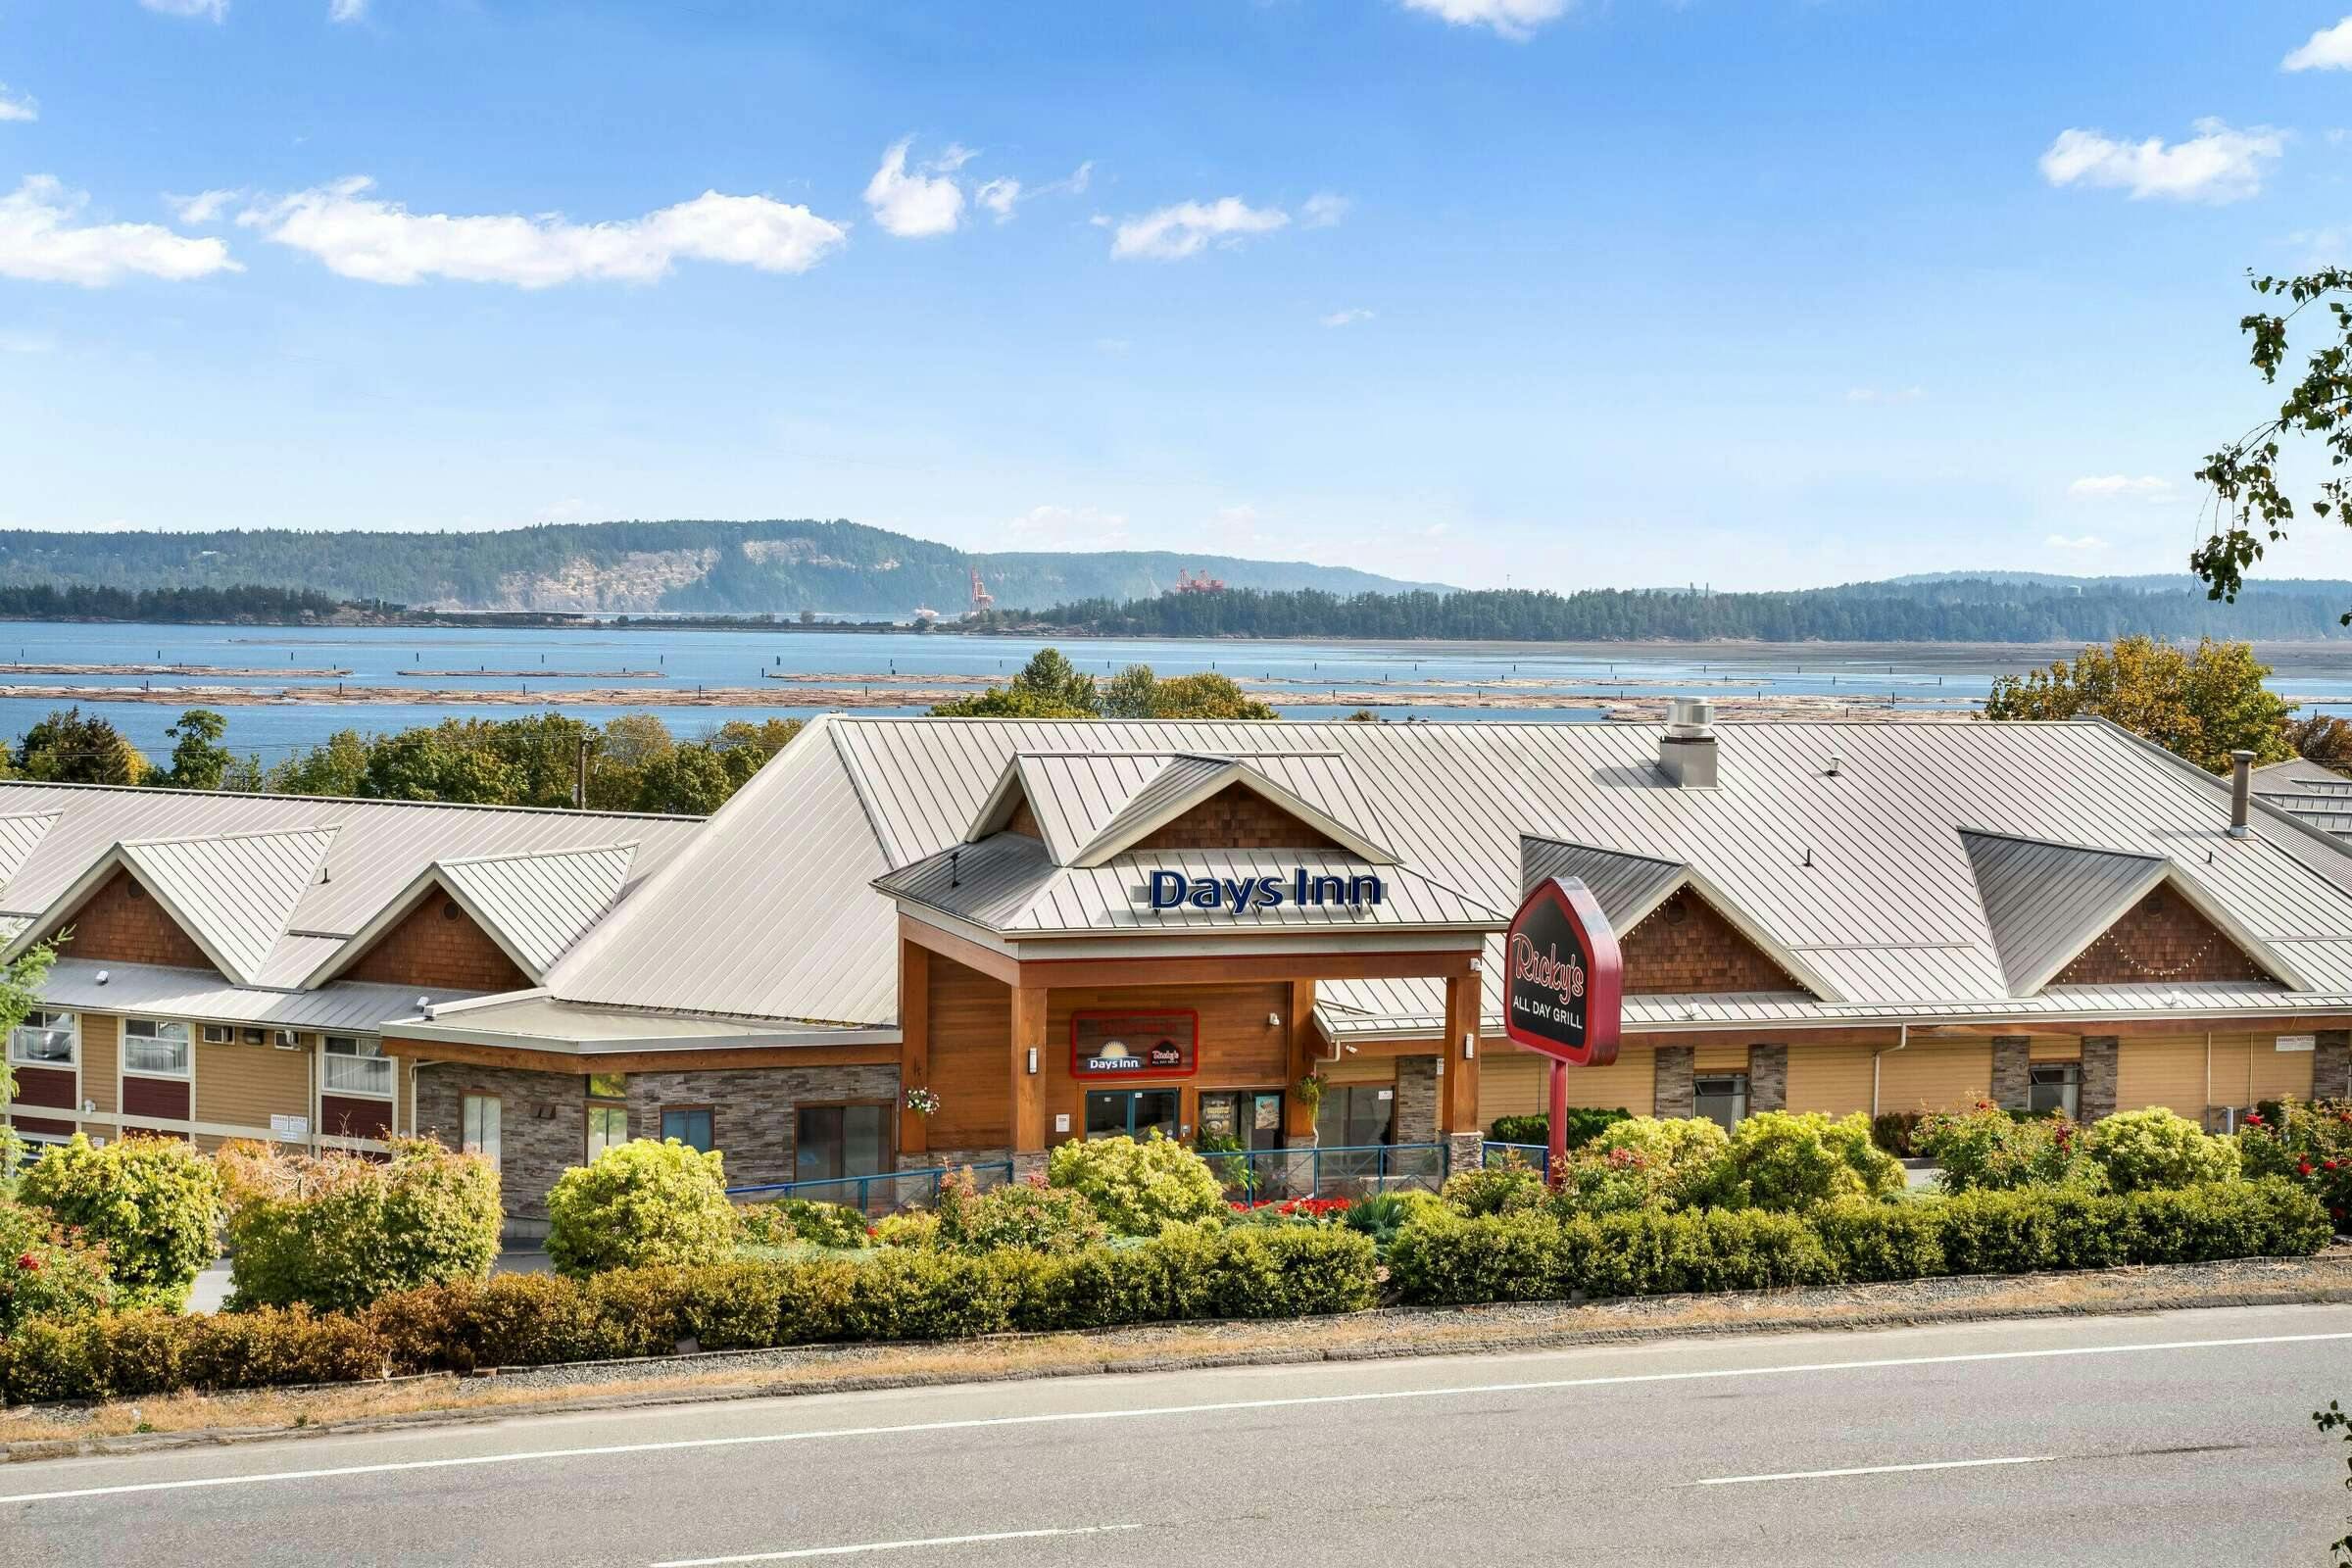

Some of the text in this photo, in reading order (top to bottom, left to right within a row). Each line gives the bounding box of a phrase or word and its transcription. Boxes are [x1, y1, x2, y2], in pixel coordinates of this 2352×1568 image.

[1150, 867, 1382, 915] Days Inn
[1512, 933, 1584, 1005] Ricky's
[1513, 995, 1583, 1030] ALL DAY GRILL
[1090, 1059, 1139, 1069] Days Inn
